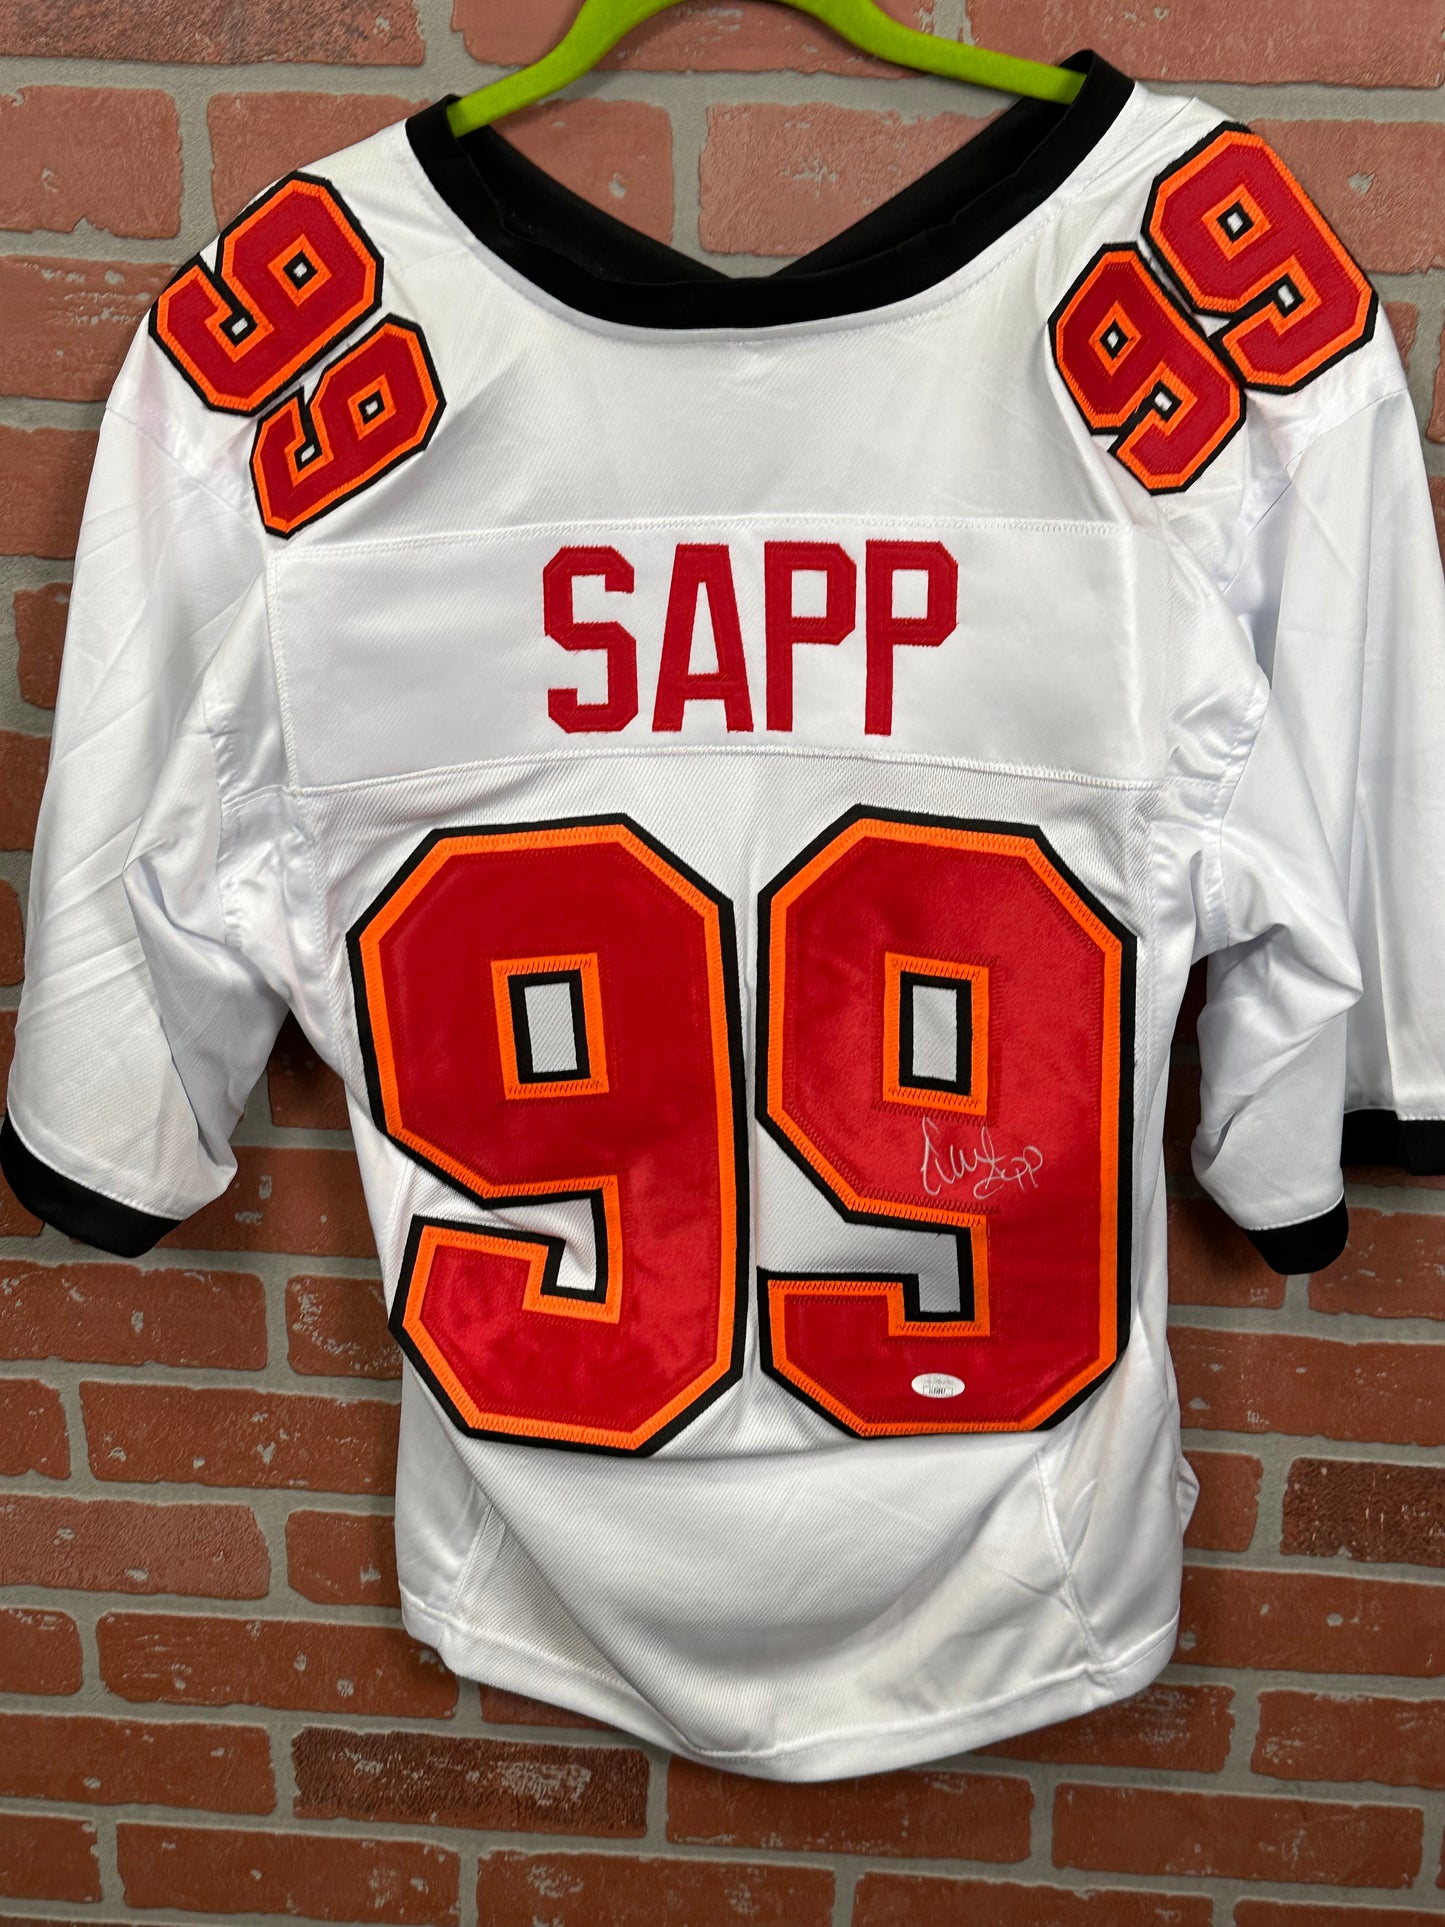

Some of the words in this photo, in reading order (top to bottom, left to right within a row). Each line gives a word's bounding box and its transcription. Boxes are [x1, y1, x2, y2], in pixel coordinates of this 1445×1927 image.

[148, 170, 447, 540] 99
[1047, 120, 1379, 496] 99
[543, 539, 958, 736] SAPP
[345, 804, 1137, 1457] 99
